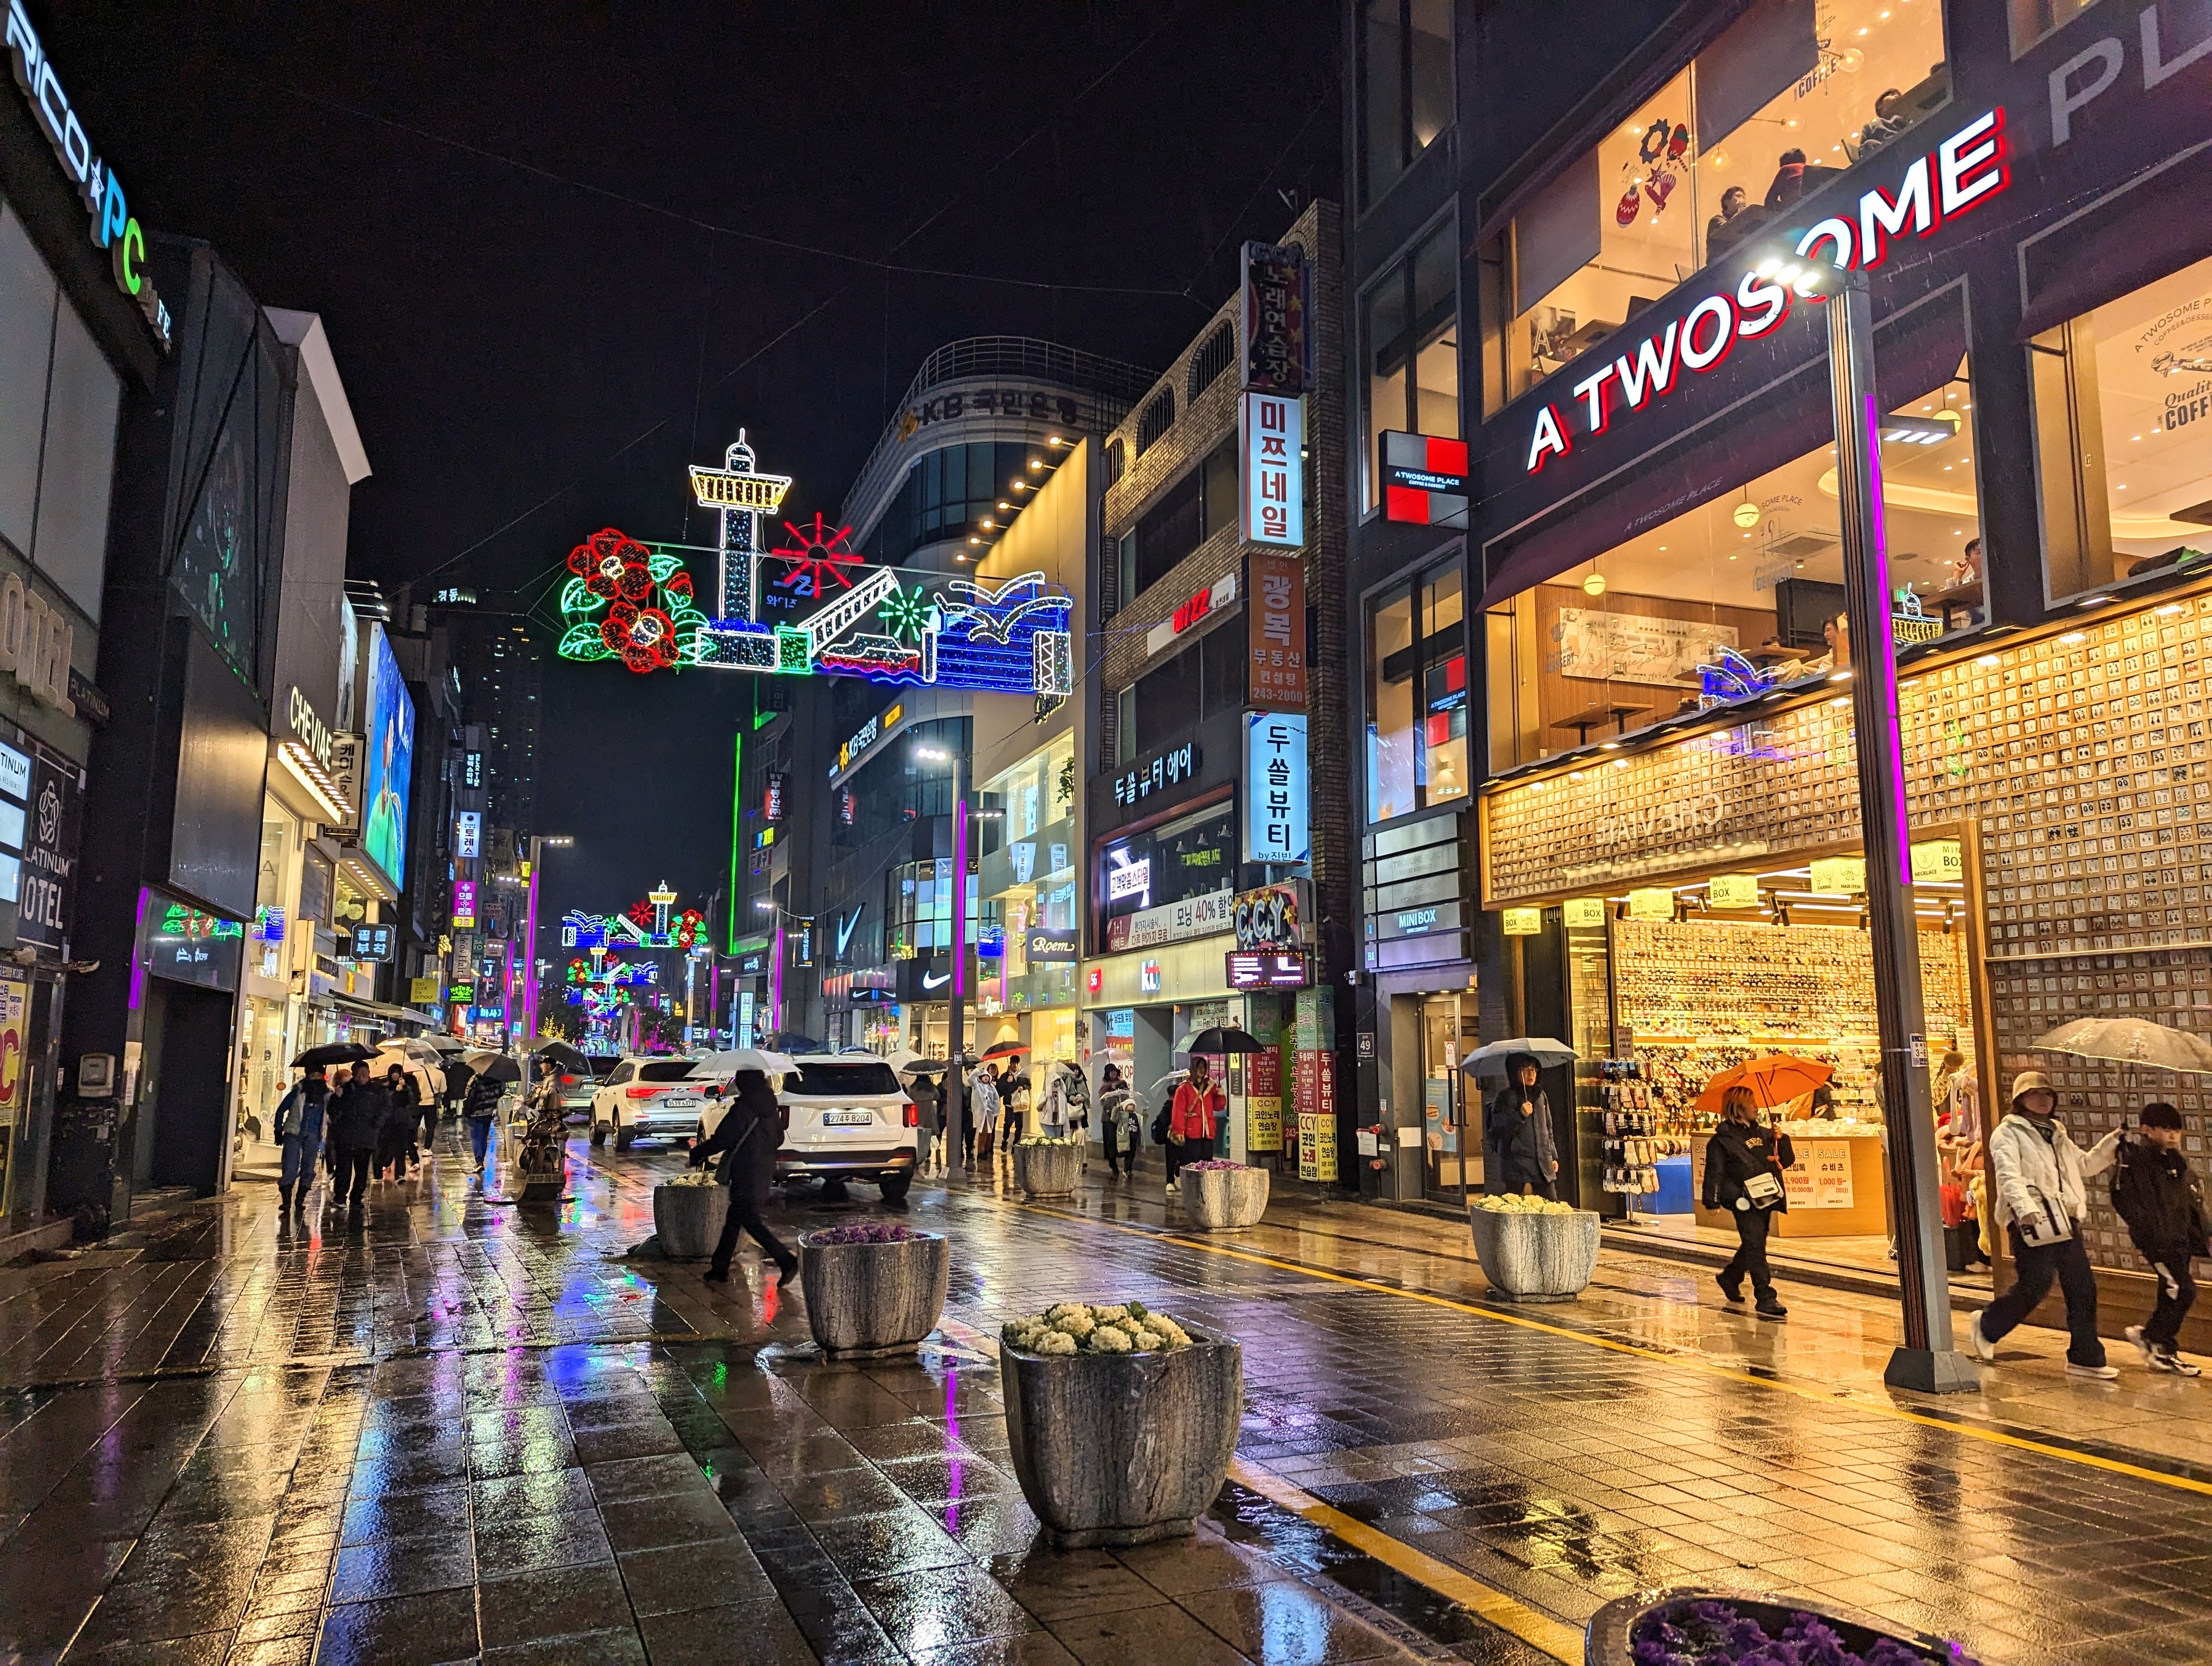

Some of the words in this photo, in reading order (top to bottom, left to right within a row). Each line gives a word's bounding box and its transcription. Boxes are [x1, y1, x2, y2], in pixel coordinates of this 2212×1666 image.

[1798, 56, 1837, 98] COFFEE
[1527, 407, 1569, 472] A
[1573, 108, 2007, 433] TWOSOME
[2134, 344, 2143, 353] A
[2140, 300, 2200, 342] TWOSOME
[1261, 401, 1287, 538] 미쯔네일
[1400, 471, 1436, 483] TWOSOME
[1437, 476, 1459, 485] PLACE
[1633, 495, 1686, 527] TWOSOME
[1687, 477, 1724, 501] PLACE
[1782, 494, 1803, 506] PLACE
[1173, 588, 1209, 633] MIZZ
[1262, 574, 1293, 646] 광복
[1253, 648, 1301, 669] 부동산
[1260, 670, 1296, 686] 컨설팅
[1253, 688, 1302, 702] 243-2000
[1141, 756, 1163, 797] 뷰티
[1167, 742, 1192, 784] 헤어
[1266, 726, 1291, 851] 두쏠뷰티
[1258, 851, 1269, 861] by
[1915, 869, 1937, 877] NECKLACE
[1713, 879, 1729, 887] MINI
[1713, 888, 1730, 898] BOX
[1177, 904, 1192, 927] 모닝
[1195, 899, 1216, 922] 40%
[1237, 893, 1285, 942] CCY
[1399, 913, 1417, 928] MINI
[1418, 909, 1436, 922] BOX
[1584, 909, 1601, 918] BOX
[1113, 921, 1123, 935] 1+1
[1506, 919, 1517, 927] BOX
[1032, 937, 1076, 953] Roem
[1367, 951, 1375, 961] B1
[484, 964, 494, 977] J
[1141, 959, 1159, 991] kt
[1107, 1014, 1114, 1031] kt
[1298, 1011, 1315, 1030] 부동산
[1360, 1040, 1371, 1050] 49
[1321, 1053, 1333, 1112] 두쏠뷰티
[1255, 1110, 1280, 1120] 코인노래
[1258, 1122, 1277, 1131] 연습장
[1300, 1116, 1316, 1131] CCY
[1321, 1119, 1334, 1128] CCY
[1302, 1133, 1315, 1147] 코인
[1320, 1132, 1336, 1144] 코인노래
[1302, 1149, 1316, 1164] 노래
[1322, 1147, 1334, 1158] 연습장
[1796, 1149, 1810, 1158] LE
[1818, 1149, 1846, 1159] SALE
[1301, 1165, 1317, 1178] 연습장
